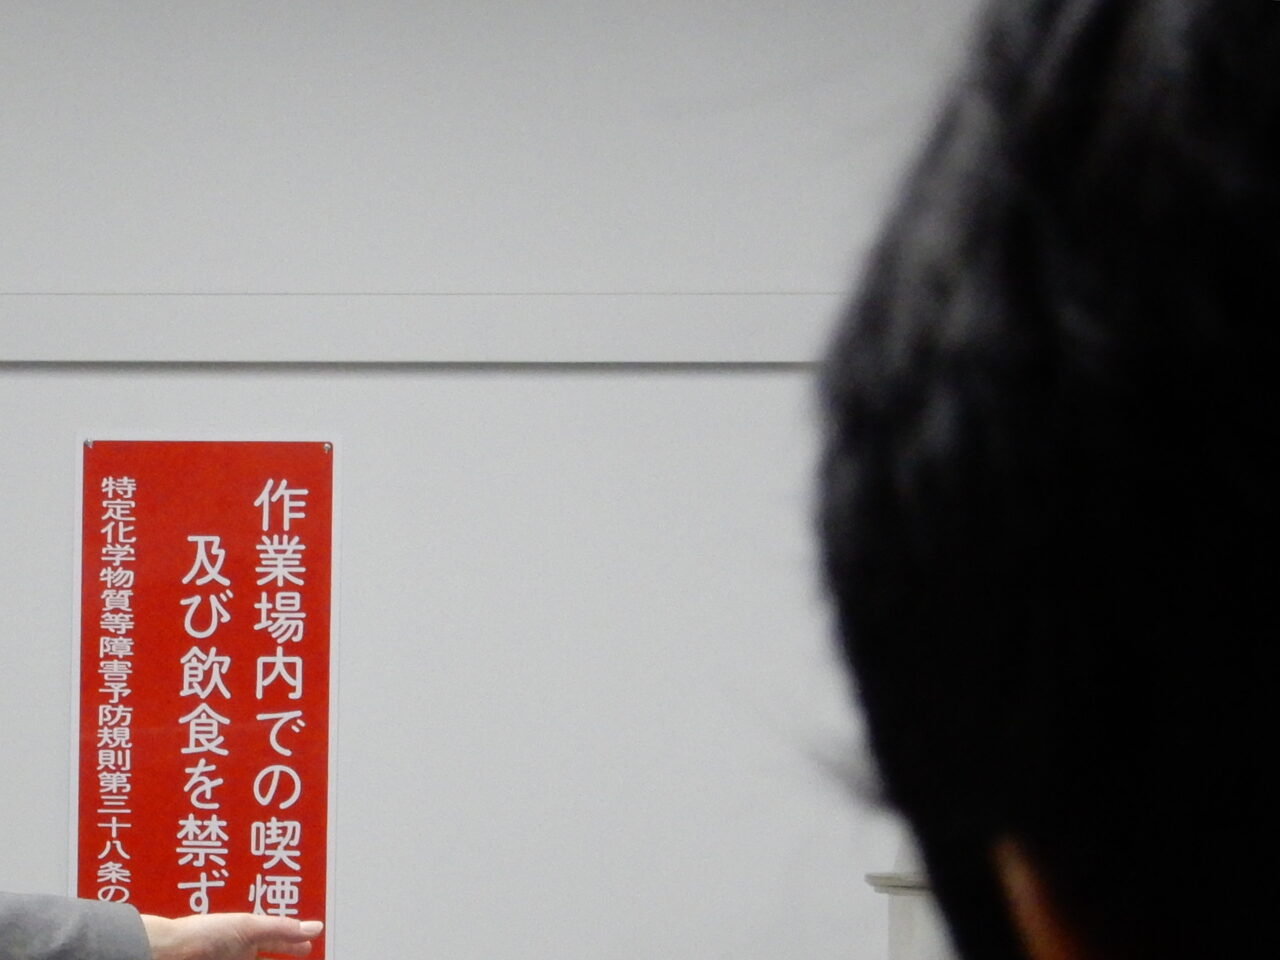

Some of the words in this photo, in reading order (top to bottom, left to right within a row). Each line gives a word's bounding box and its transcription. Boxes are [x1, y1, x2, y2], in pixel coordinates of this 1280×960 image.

[96, 475, 137, 902] 特定化学物質等障害予防規則第三十八条の
[176, 534, 233, 914] 及び飲食を禁ず
[248, 477, 309, 917] 作業場内での喫煙
